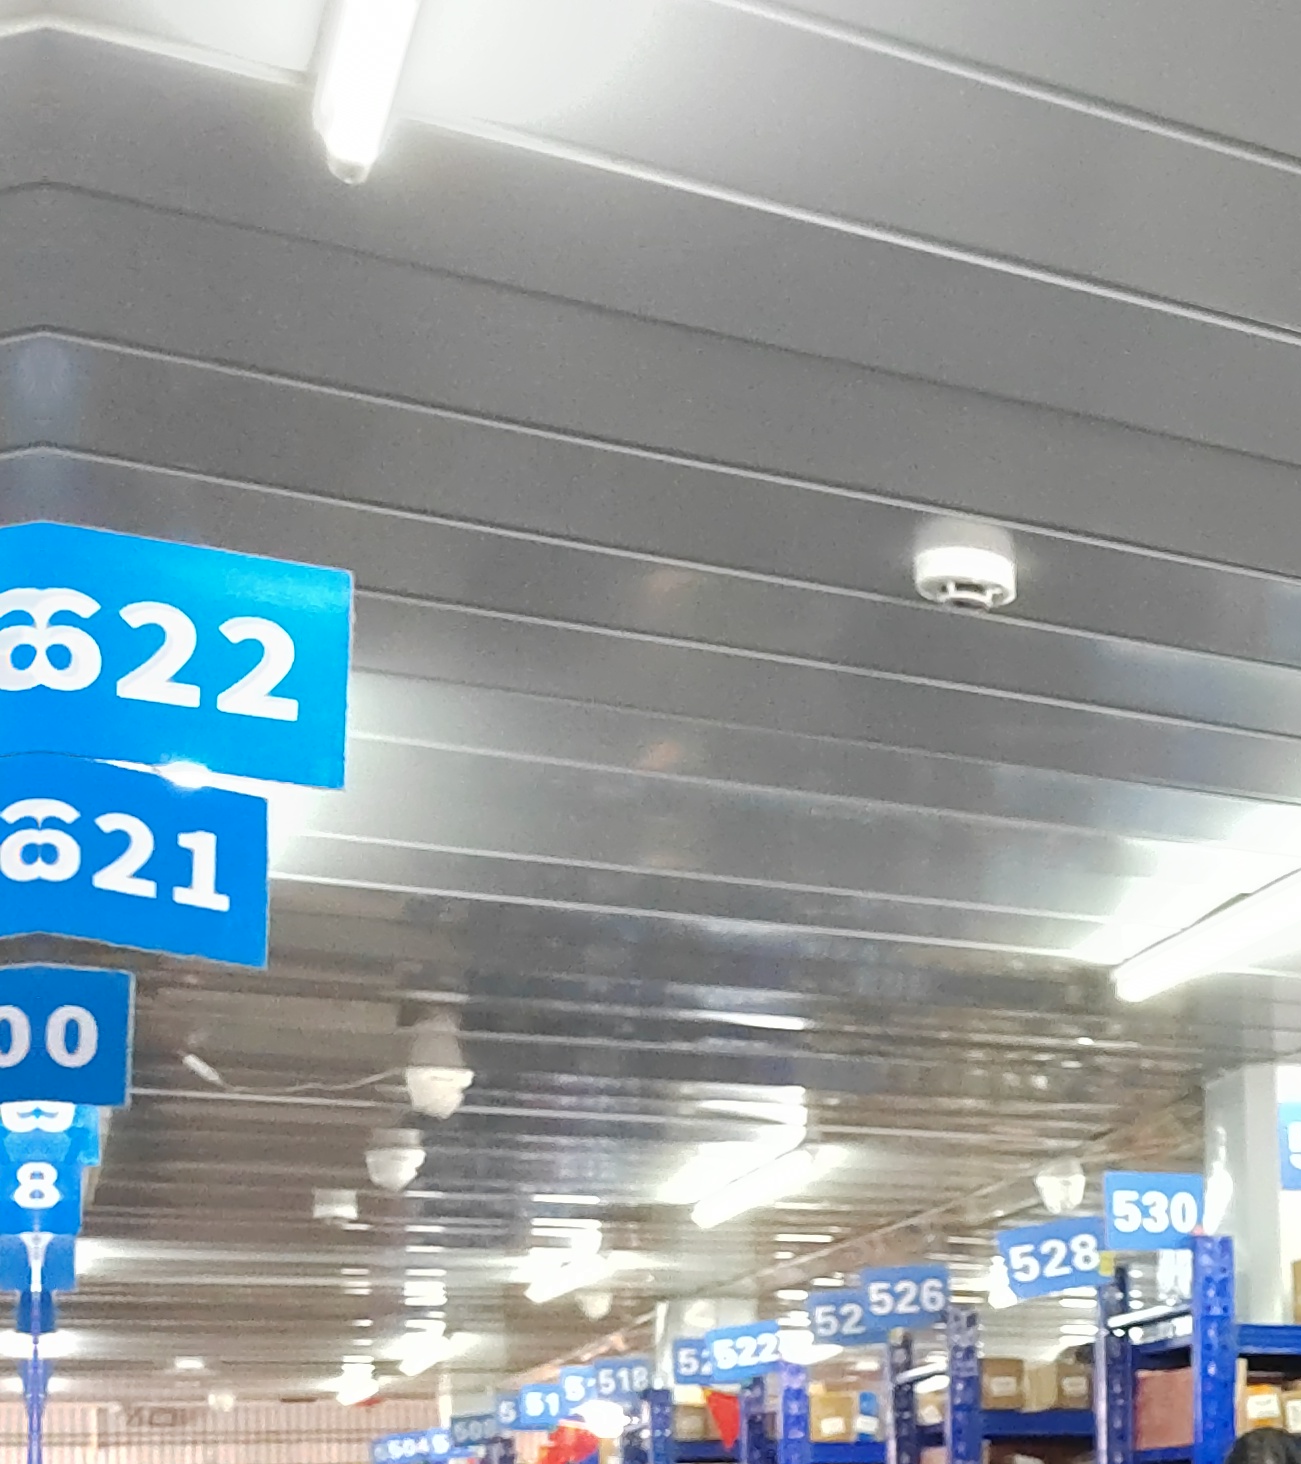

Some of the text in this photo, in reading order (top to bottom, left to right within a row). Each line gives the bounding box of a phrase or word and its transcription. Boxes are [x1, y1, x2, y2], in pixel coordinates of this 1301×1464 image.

[1112, 1190, 1198, 1233] 530
[1008, 1234, 1100, 1282] 528
[867, 1278, 946, 1316] 526
[813, 1303, 867, 1337] 52
[713, 1332, 780, 1370] 522
[598, 1366, 649, 1395] 518
[525, 1391, 560, 1417] 51
